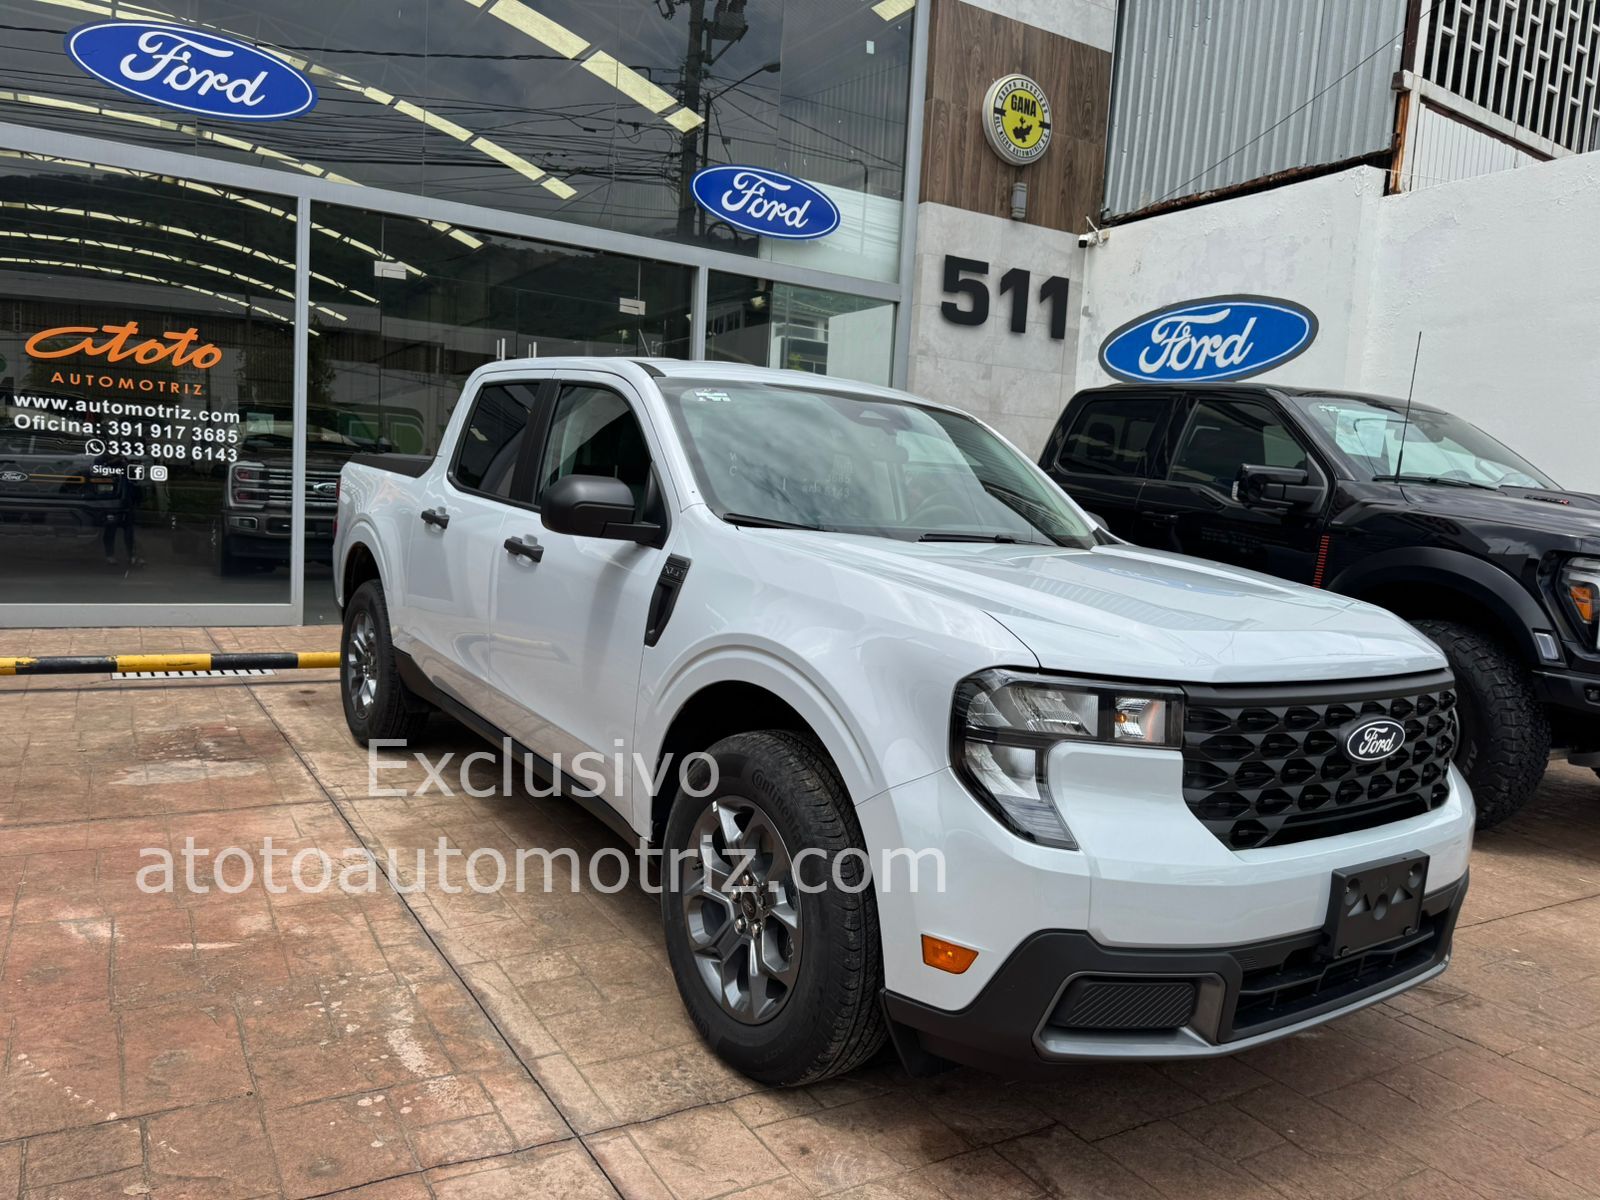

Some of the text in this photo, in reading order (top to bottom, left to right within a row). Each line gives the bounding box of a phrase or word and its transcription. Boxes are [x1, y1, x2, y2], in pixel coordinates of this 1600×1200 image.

[119, 30, 267, 107] Ford
[1011, 94, 1037, 118] GANA
[721, 172, 811, 228] Ford
[940, 254, 1070, 340] 511
[24, 321, 223, 369] atoto
[1138, 308, 1258, 373] Ford
[51, 371, 204, 396] AUTOMOTRIZ
[13, 395, 241, 424] www.automotriz.com
[13, 413, 239, 444] Oficina: 391 917 3685
[108, 440, 239, 463] 333 808 6143
[92, 464, 125, 476] Sigue:
[1358, 726, 1396, 756] Ford
